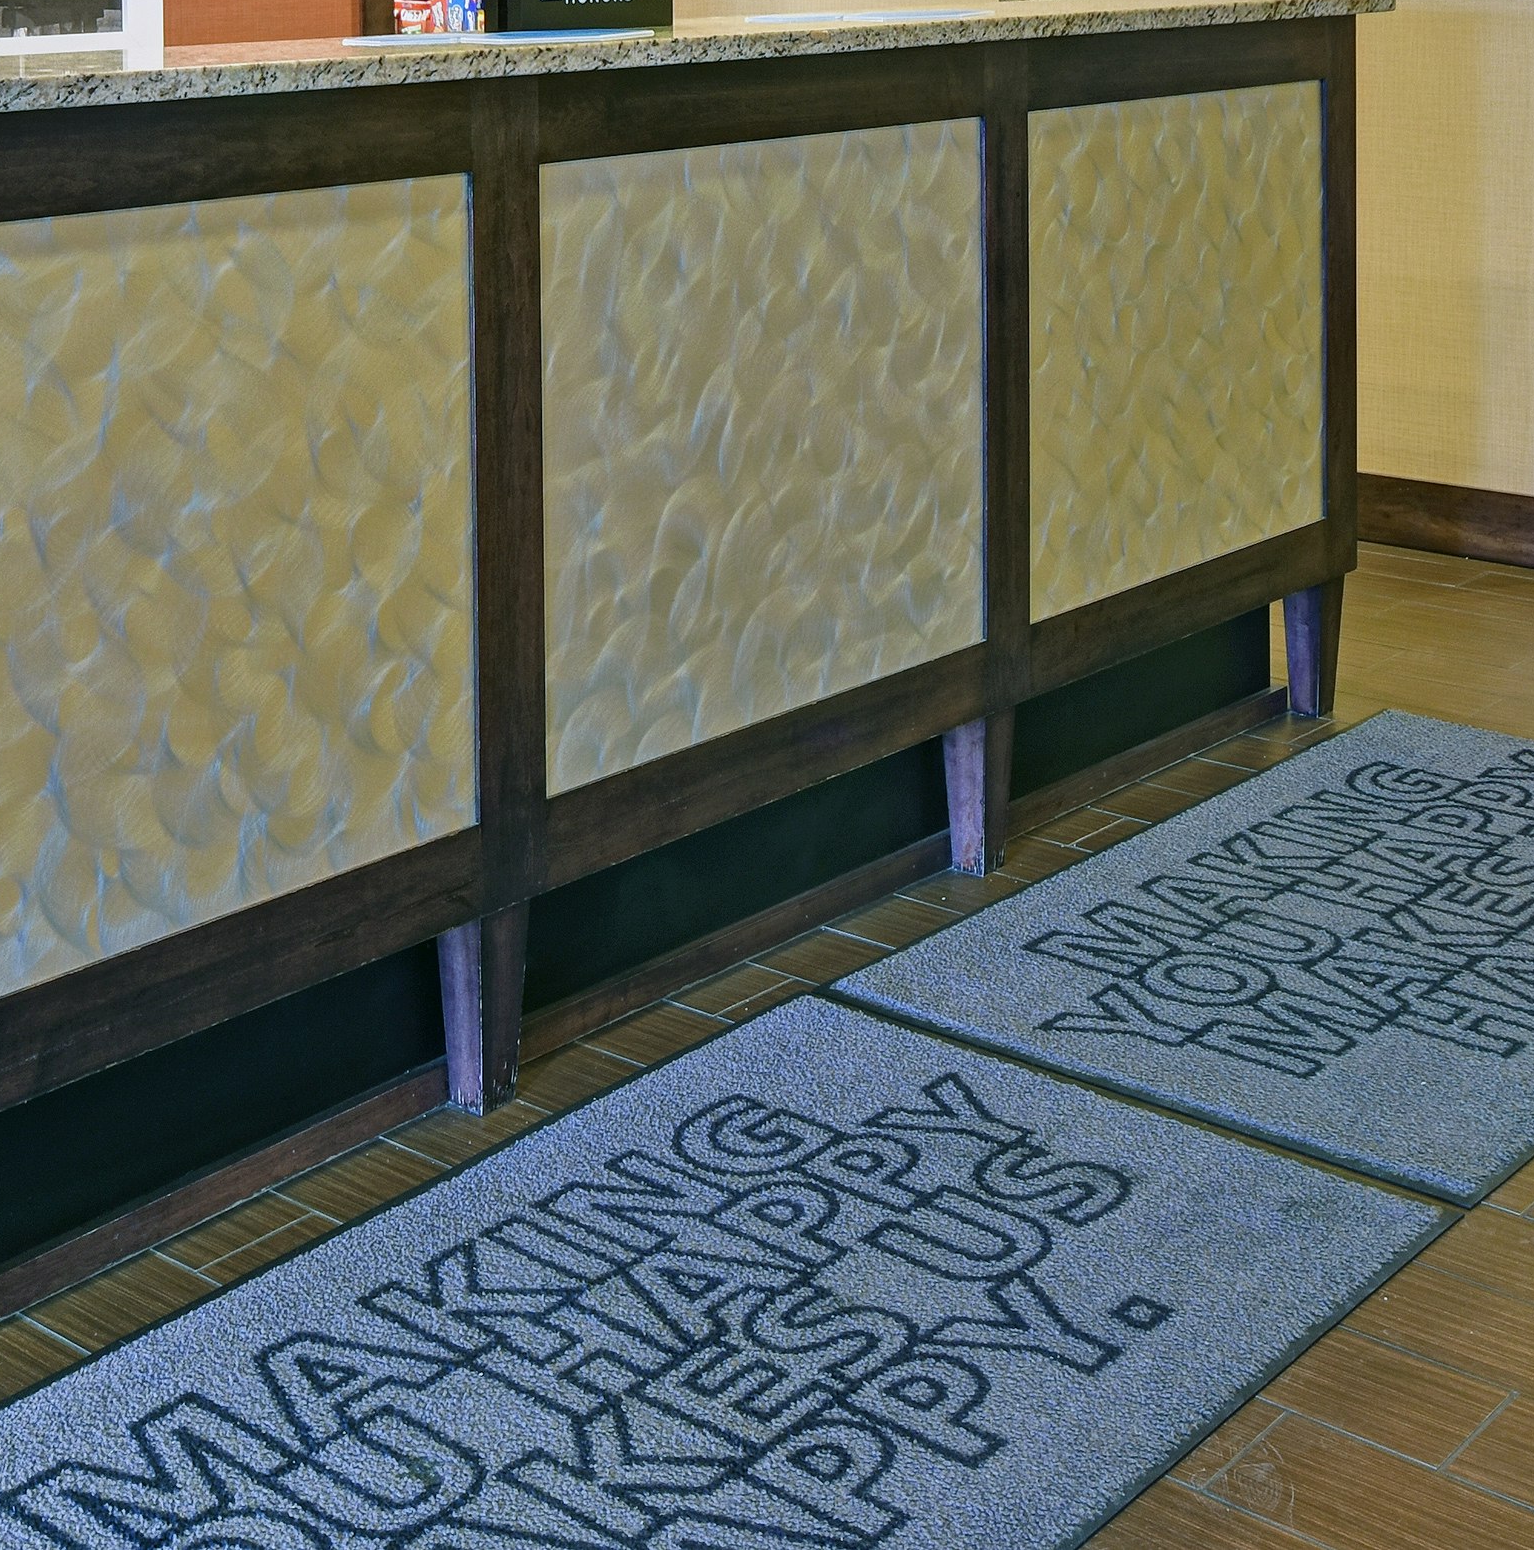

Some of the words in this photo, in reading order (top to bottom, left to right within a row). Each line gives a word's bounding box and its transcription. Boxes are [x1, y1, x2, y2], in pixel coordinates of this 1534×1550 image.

[1025, 762, 1469, 977] MAKING
[1035, 906, 1343, 1048] YOU
[470, 1072, 1035, 1420] HAPPY
[869, 1145, 1136, 1281] US
